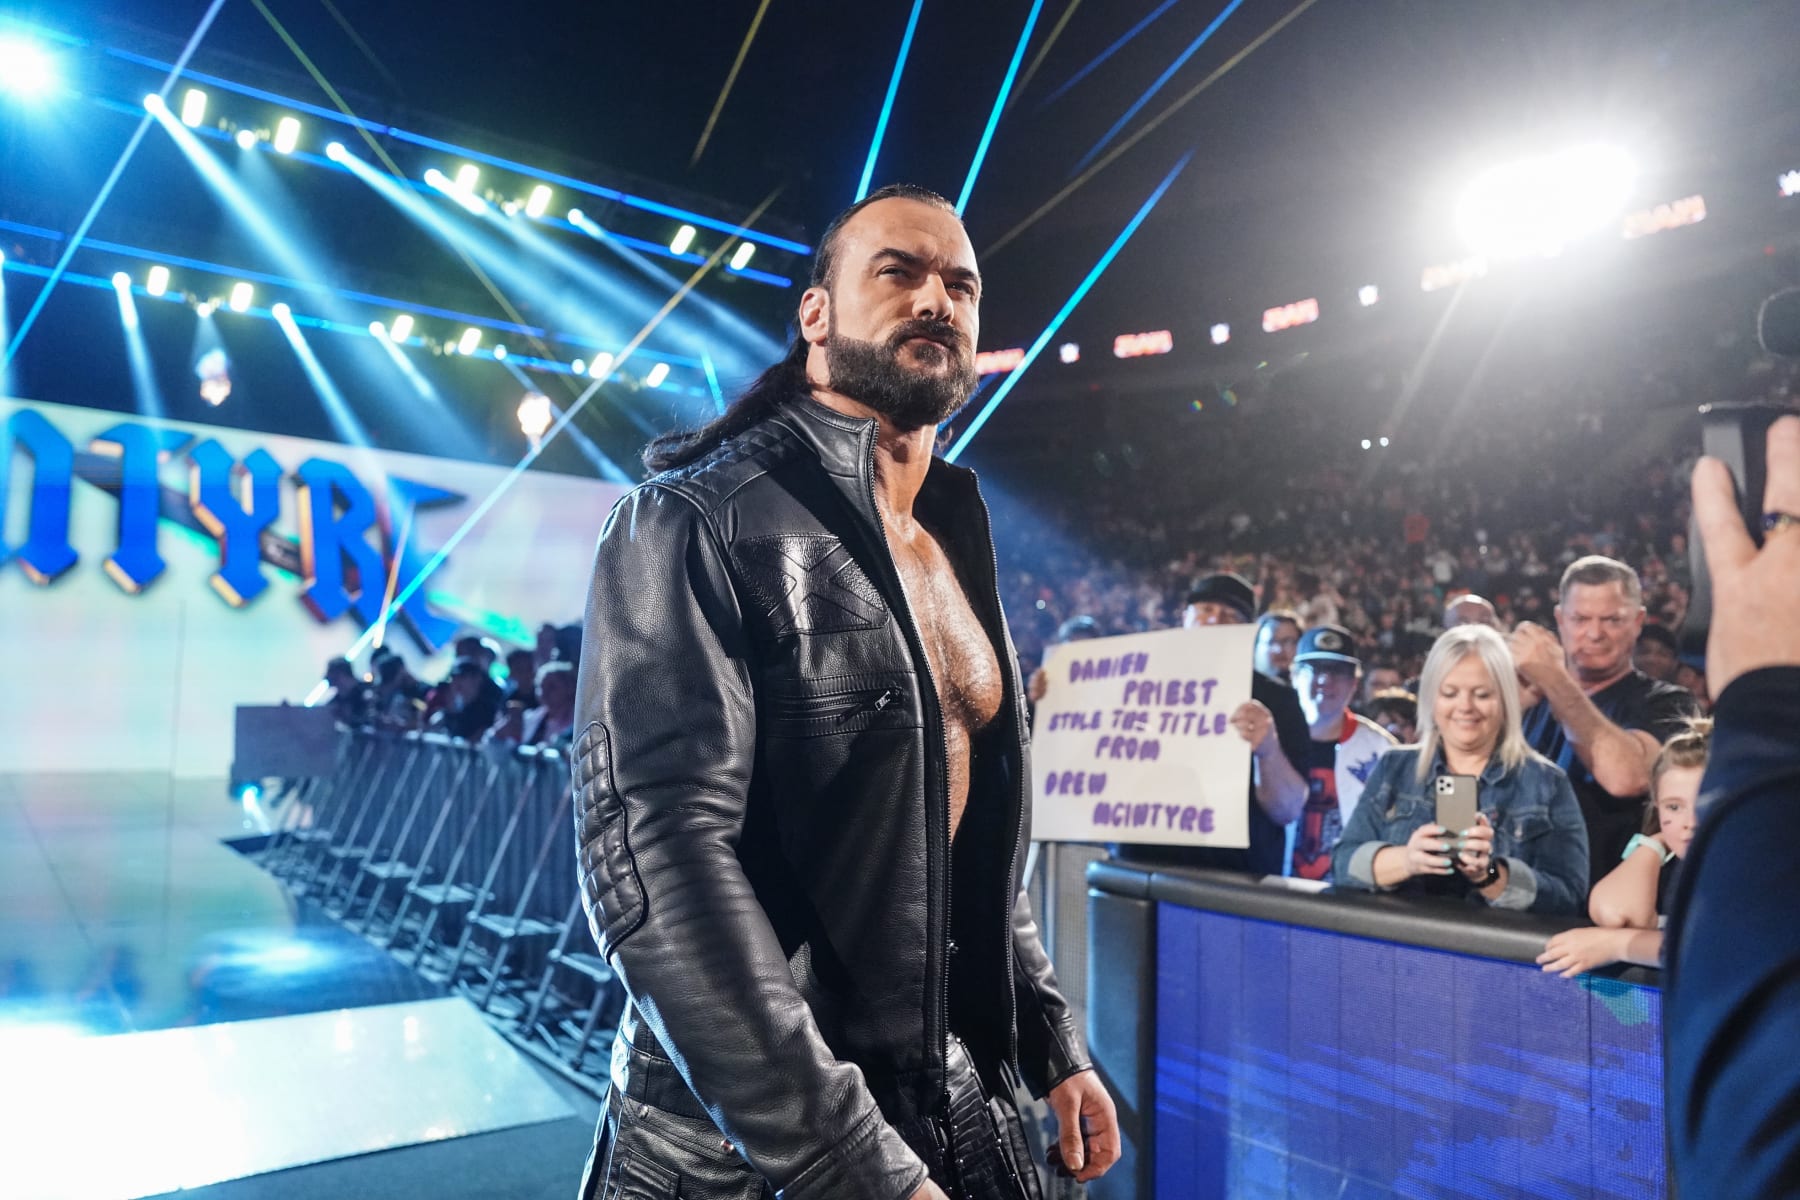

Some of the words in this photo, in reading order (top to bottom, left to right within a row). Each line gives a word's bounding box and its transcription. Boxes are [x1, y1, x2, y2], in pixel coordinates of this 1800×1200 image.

[1069, 652, 1149, 683] DAMIEN
[1123, 679, 1218, 706] PRIEST
[1048, 709, 1102, 732] STOLE
[1112, 709, 1149, 732] THE
[1158, 711, 1227, 736] TITLE
[1095, 735, 1160, 761] FROM
[1045, 771, 1107, 796] DREW
[1093, 802, 1215, 833] MCINTYRE
